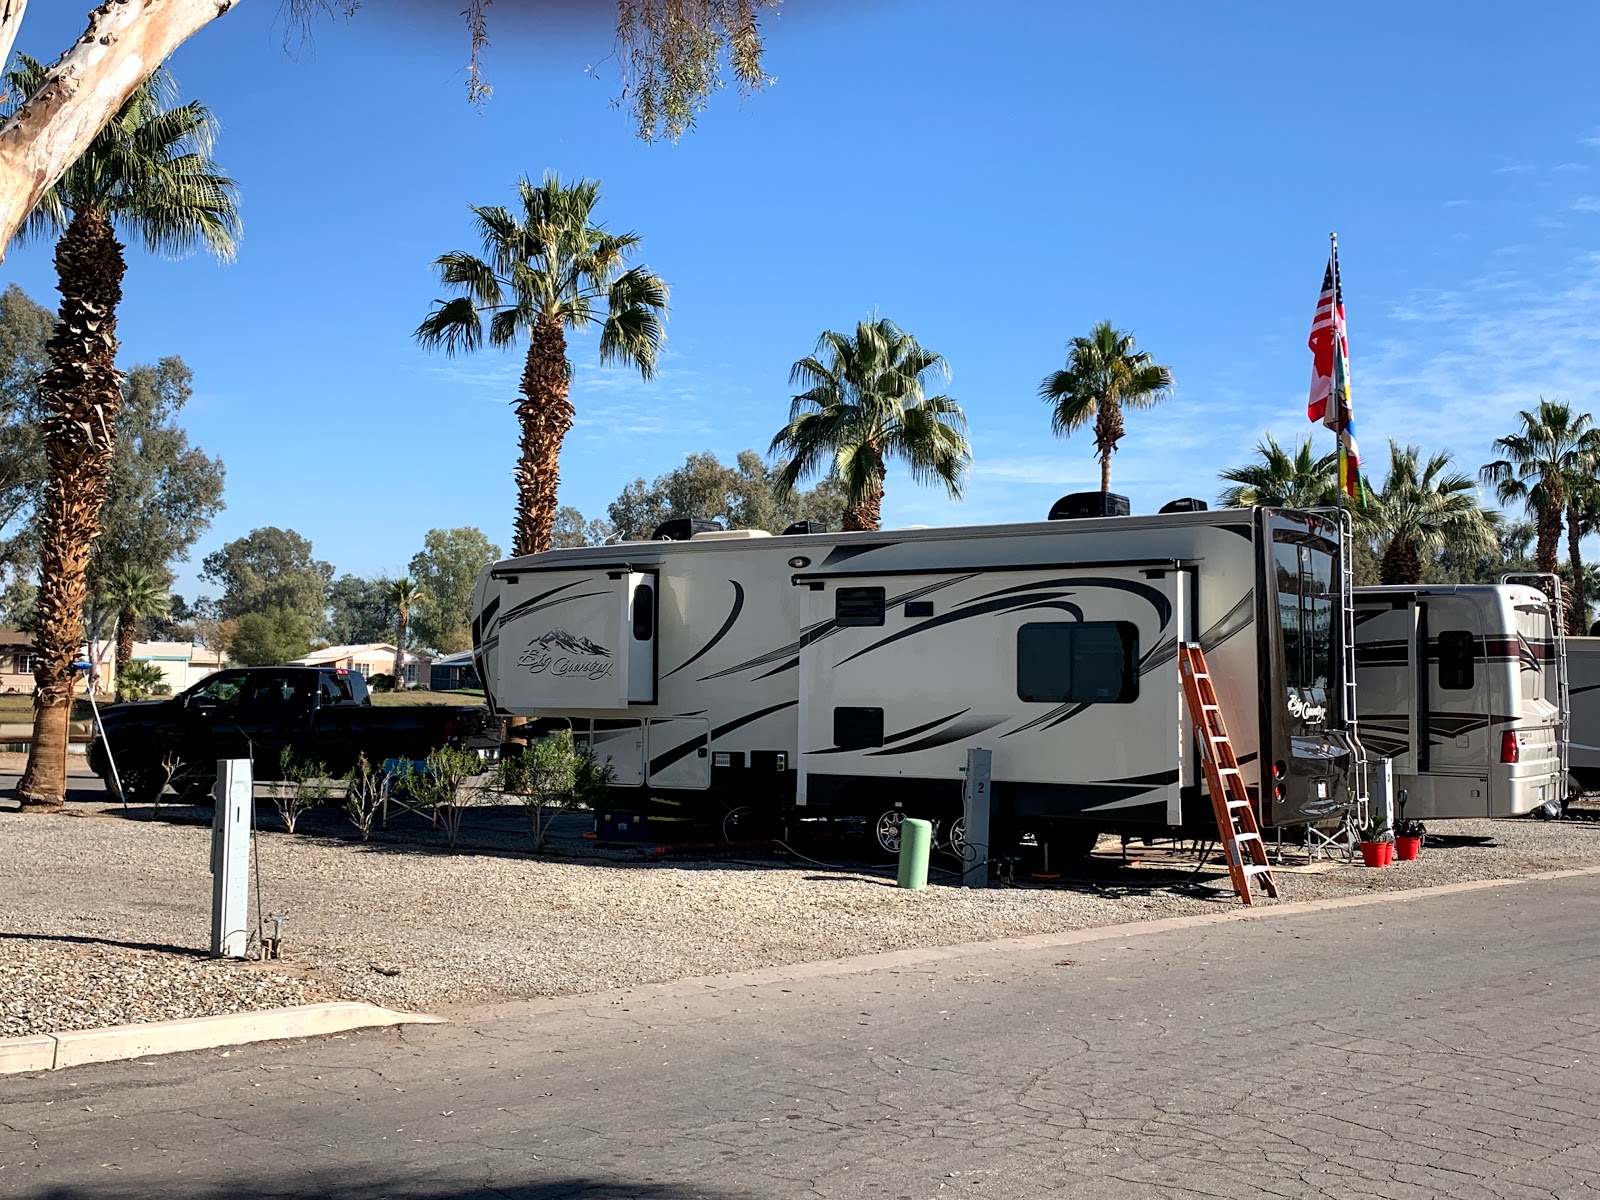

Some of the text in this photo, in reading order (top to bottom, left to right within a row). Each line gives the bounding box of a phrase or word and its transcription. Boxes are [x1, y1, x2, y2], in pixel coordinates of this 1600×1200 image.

[517, 649, 613, 681] Big Country
[1287, 694, 1326, 724] Big Country
[978, 782, 985, 794] 2
[236, 806, 240, 823] 1
